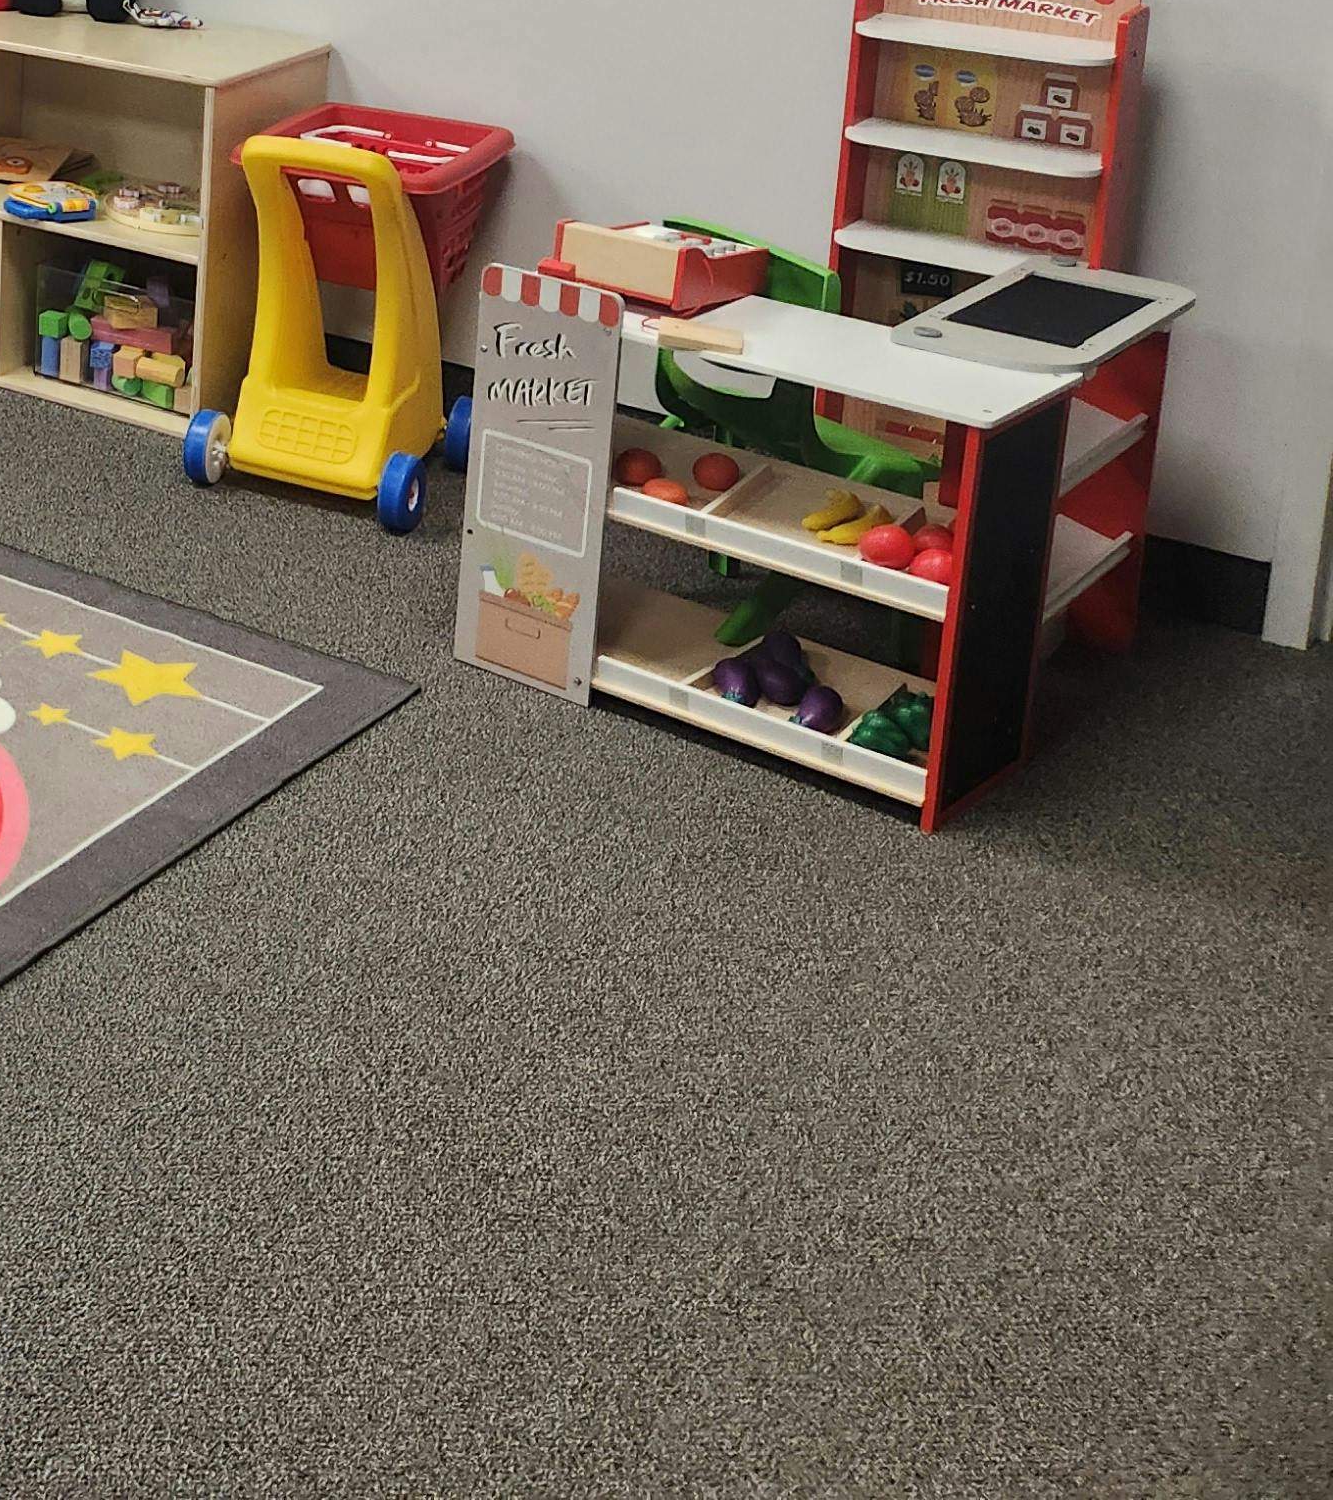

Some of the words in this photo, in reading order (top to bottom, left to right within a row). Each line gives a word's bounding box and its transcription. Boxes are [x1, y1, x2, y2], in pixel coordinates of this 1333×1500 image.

[903, 270, 950, 287] $1.50
[493, 321, 577, 359] Fresh
[487, 376, 599, 407] MARKET
